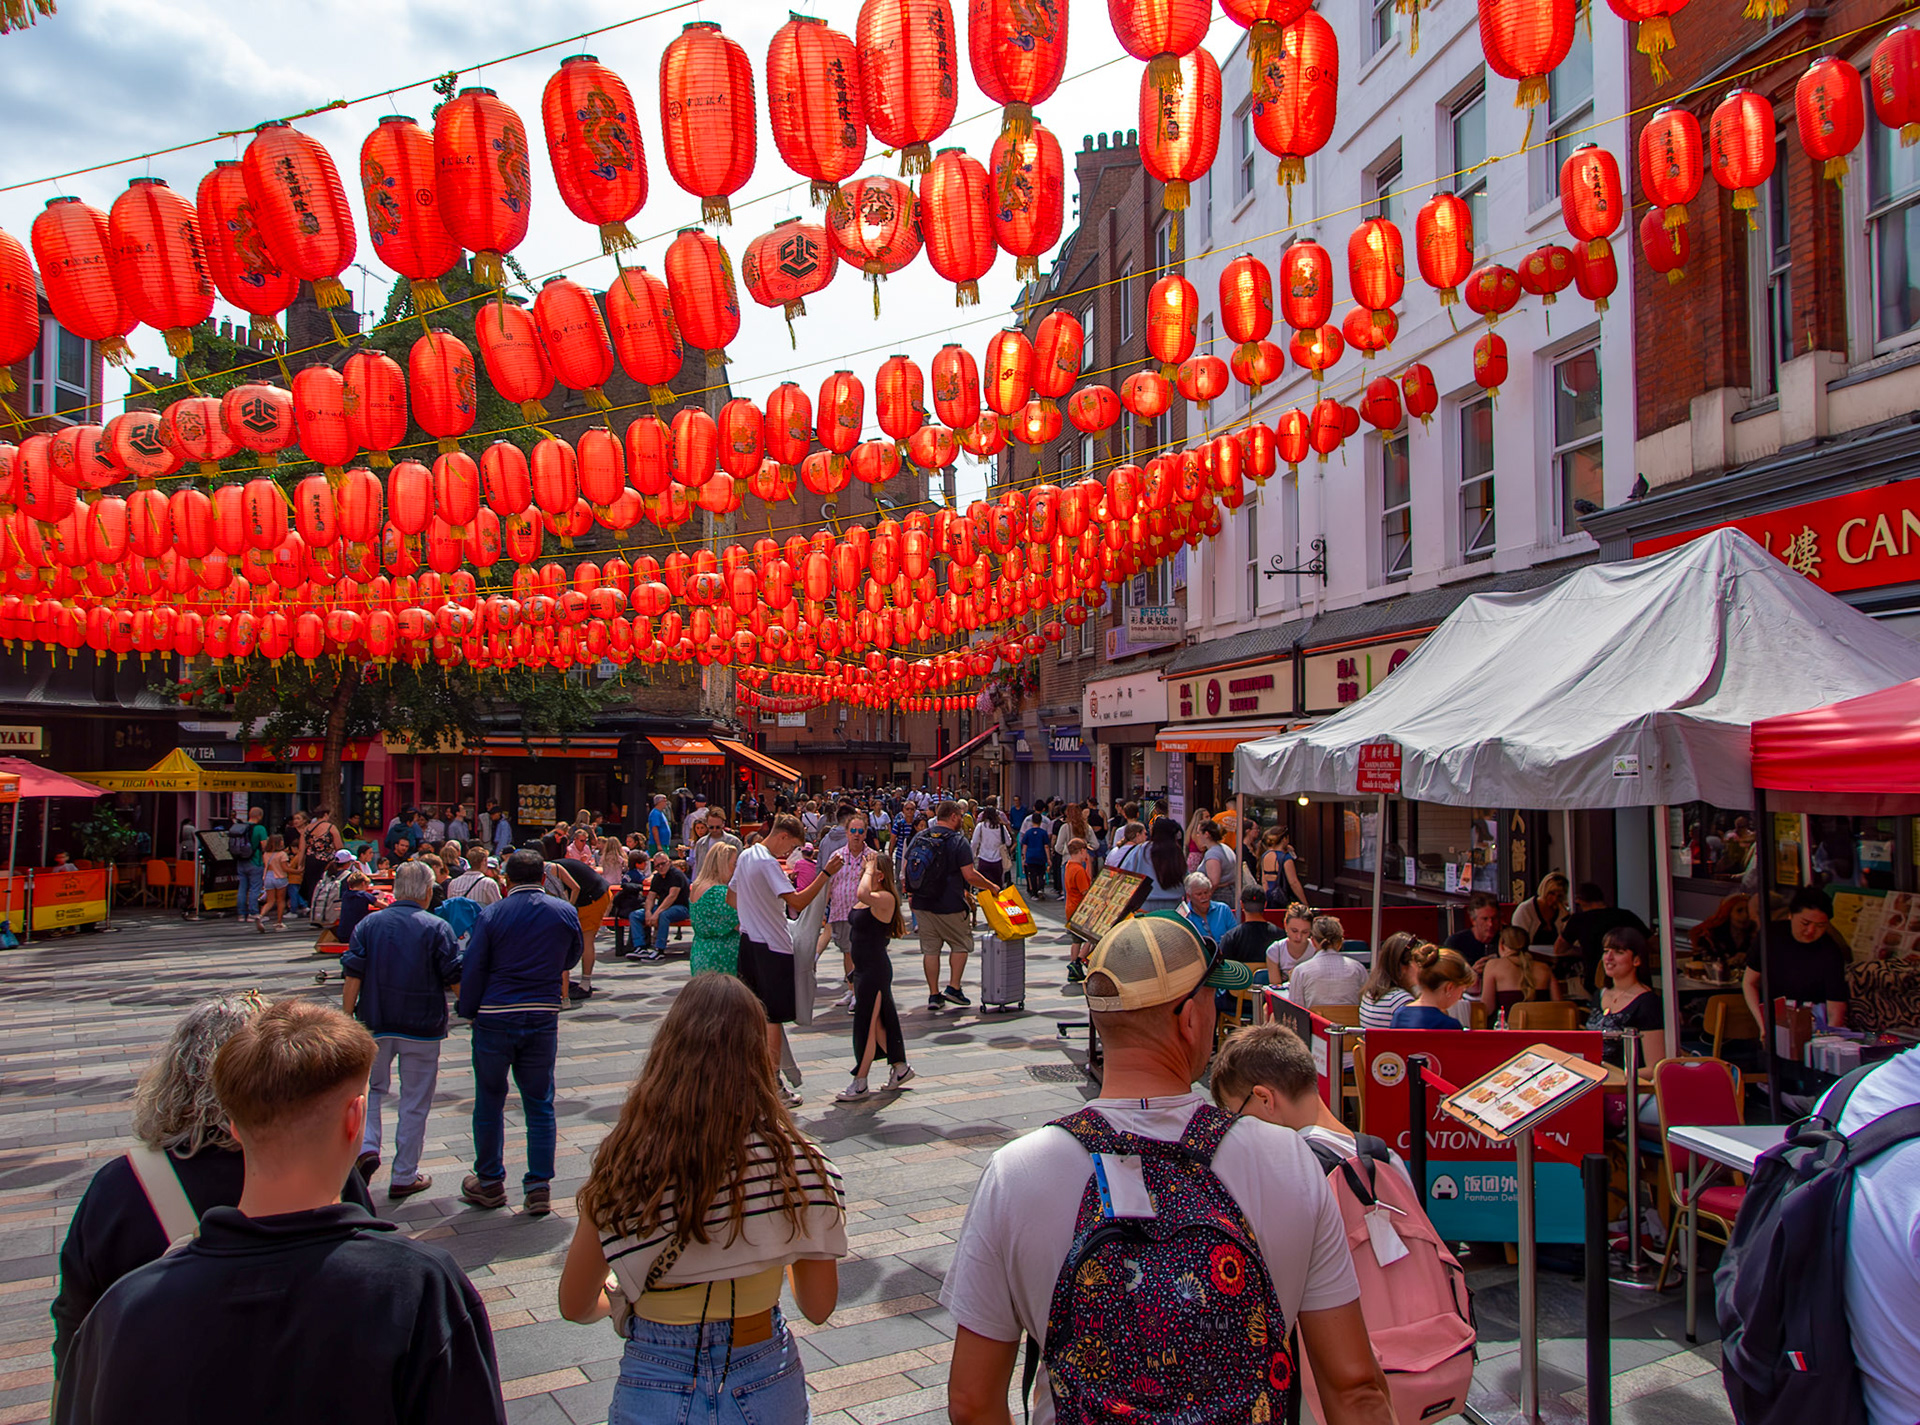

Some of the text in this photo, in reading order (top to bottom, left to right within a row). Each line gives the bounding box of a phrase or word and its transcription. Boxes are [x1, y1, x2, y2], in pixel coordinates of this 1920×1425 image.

[1055, 737, 1079, 752] CORAL
[199, 748, 214, 759] TEA
[680, 757, 709, 765] WELCOME
[1464, 1193, 1499, 1201] Fantuan
